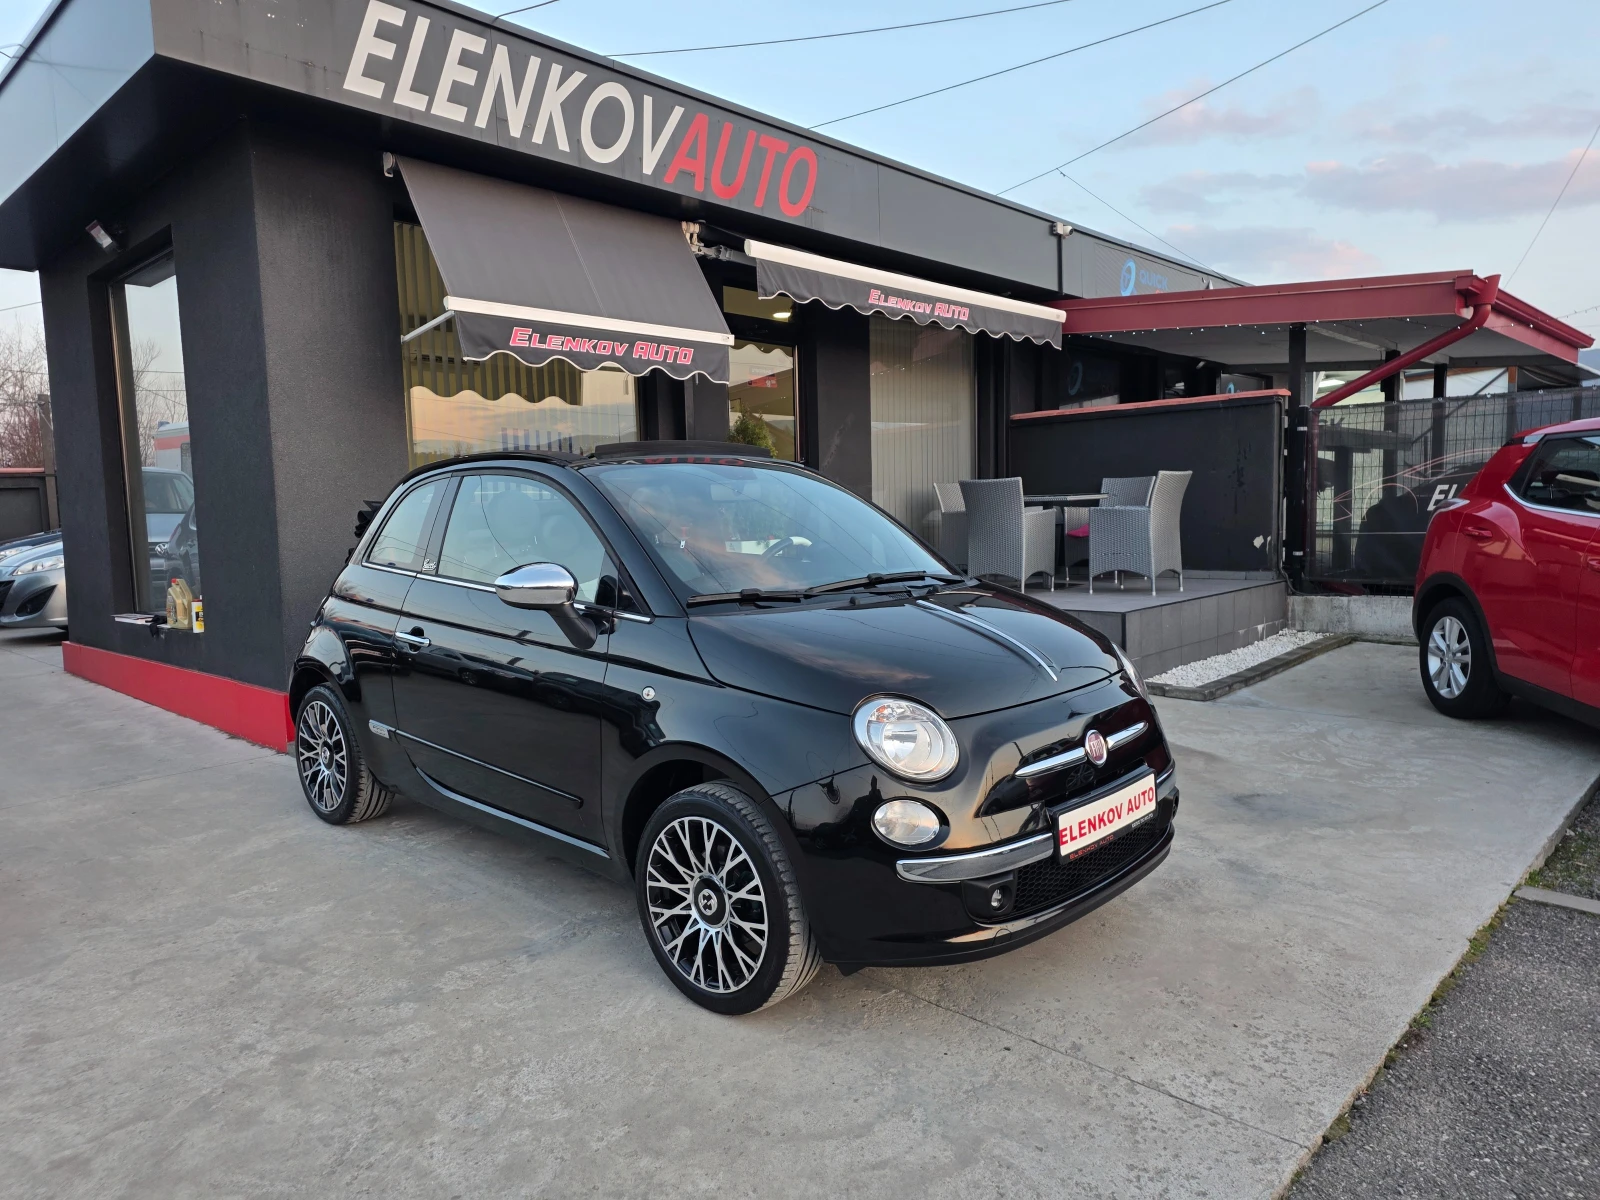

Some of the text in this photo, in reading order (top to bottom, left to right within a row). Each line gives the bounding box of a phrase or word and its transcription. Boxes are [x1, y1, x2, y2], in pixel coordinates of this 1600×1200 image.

[868, 289, 969, 320] ELENKOV AUTO
[509, 327, 694, 365] ELENKOV AUTO
[1059, 803, 1123, 846] ELENKOV
[1127, 786, 1155, 815] AUTO
